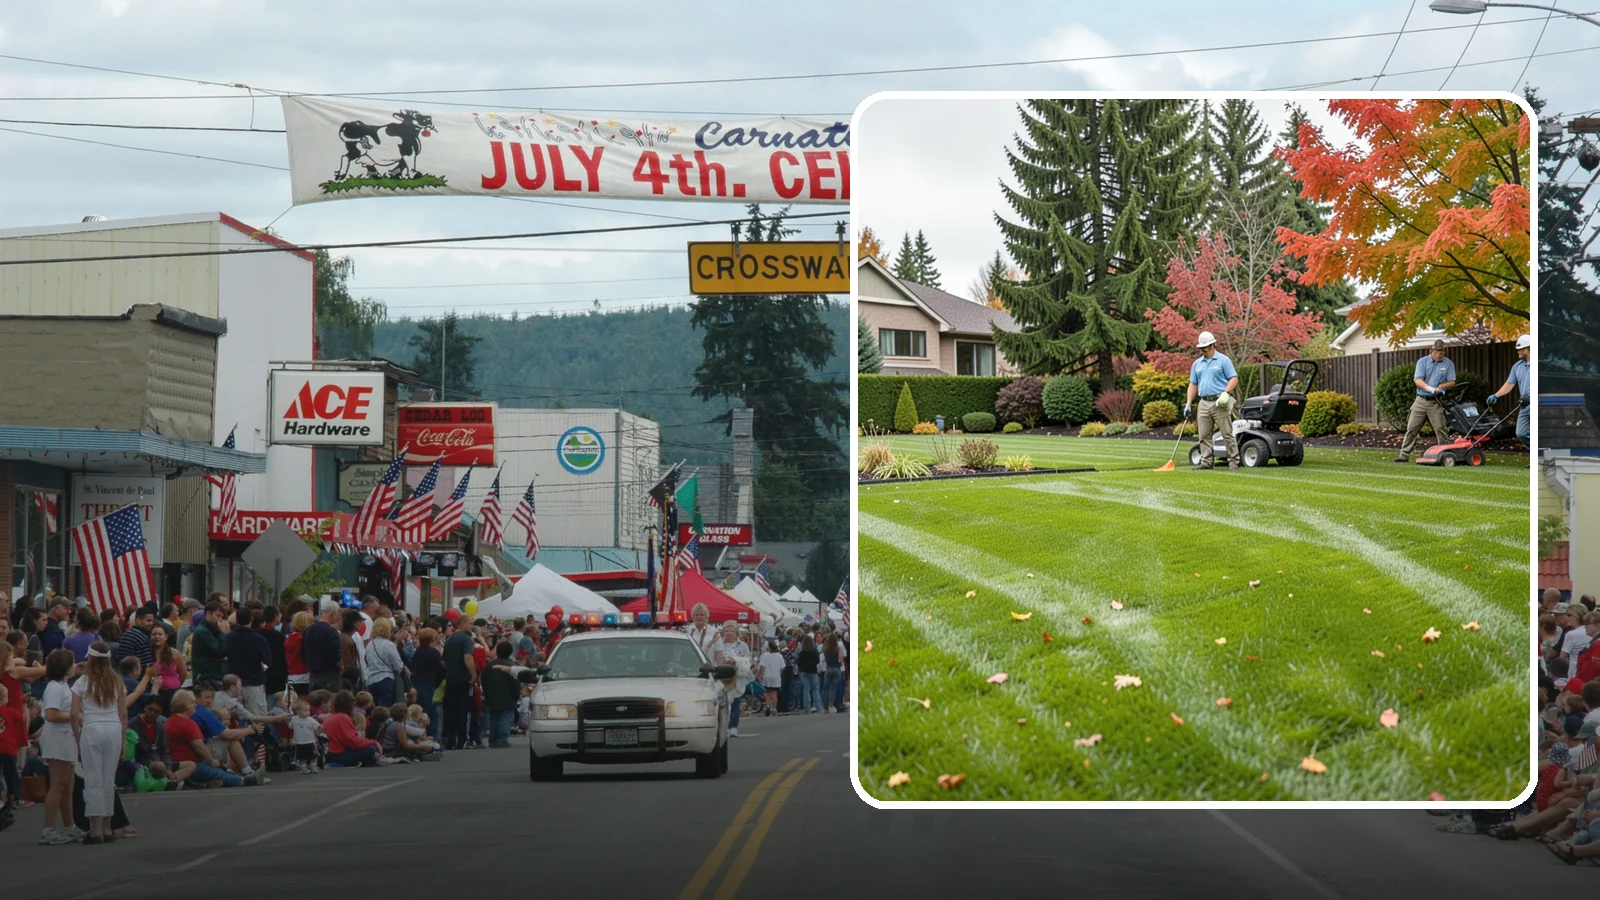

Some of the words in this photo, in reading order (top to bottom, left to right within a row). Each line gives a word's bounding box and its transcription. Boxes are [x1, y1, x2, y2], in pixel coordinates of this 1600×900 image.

[481, 141, 605, 193] JULY
[632, 150, 746, 198] 4th.
[697, 254, 850, 280] CROSSWA
[283, 380, 373, 419] ACE
[405, 409, 452, 422] CEDAR
[461, 409, 485, 422] LOG
[283, 421, 371, 436] Hardware
[95, 485, 124, 495] Vincent
[126, 486, 136, 495] de
[137, 486, 155, 495] Paul
[688, 526, 741, 535] CRNATION
[699, 535, 730, 543] GLASS
